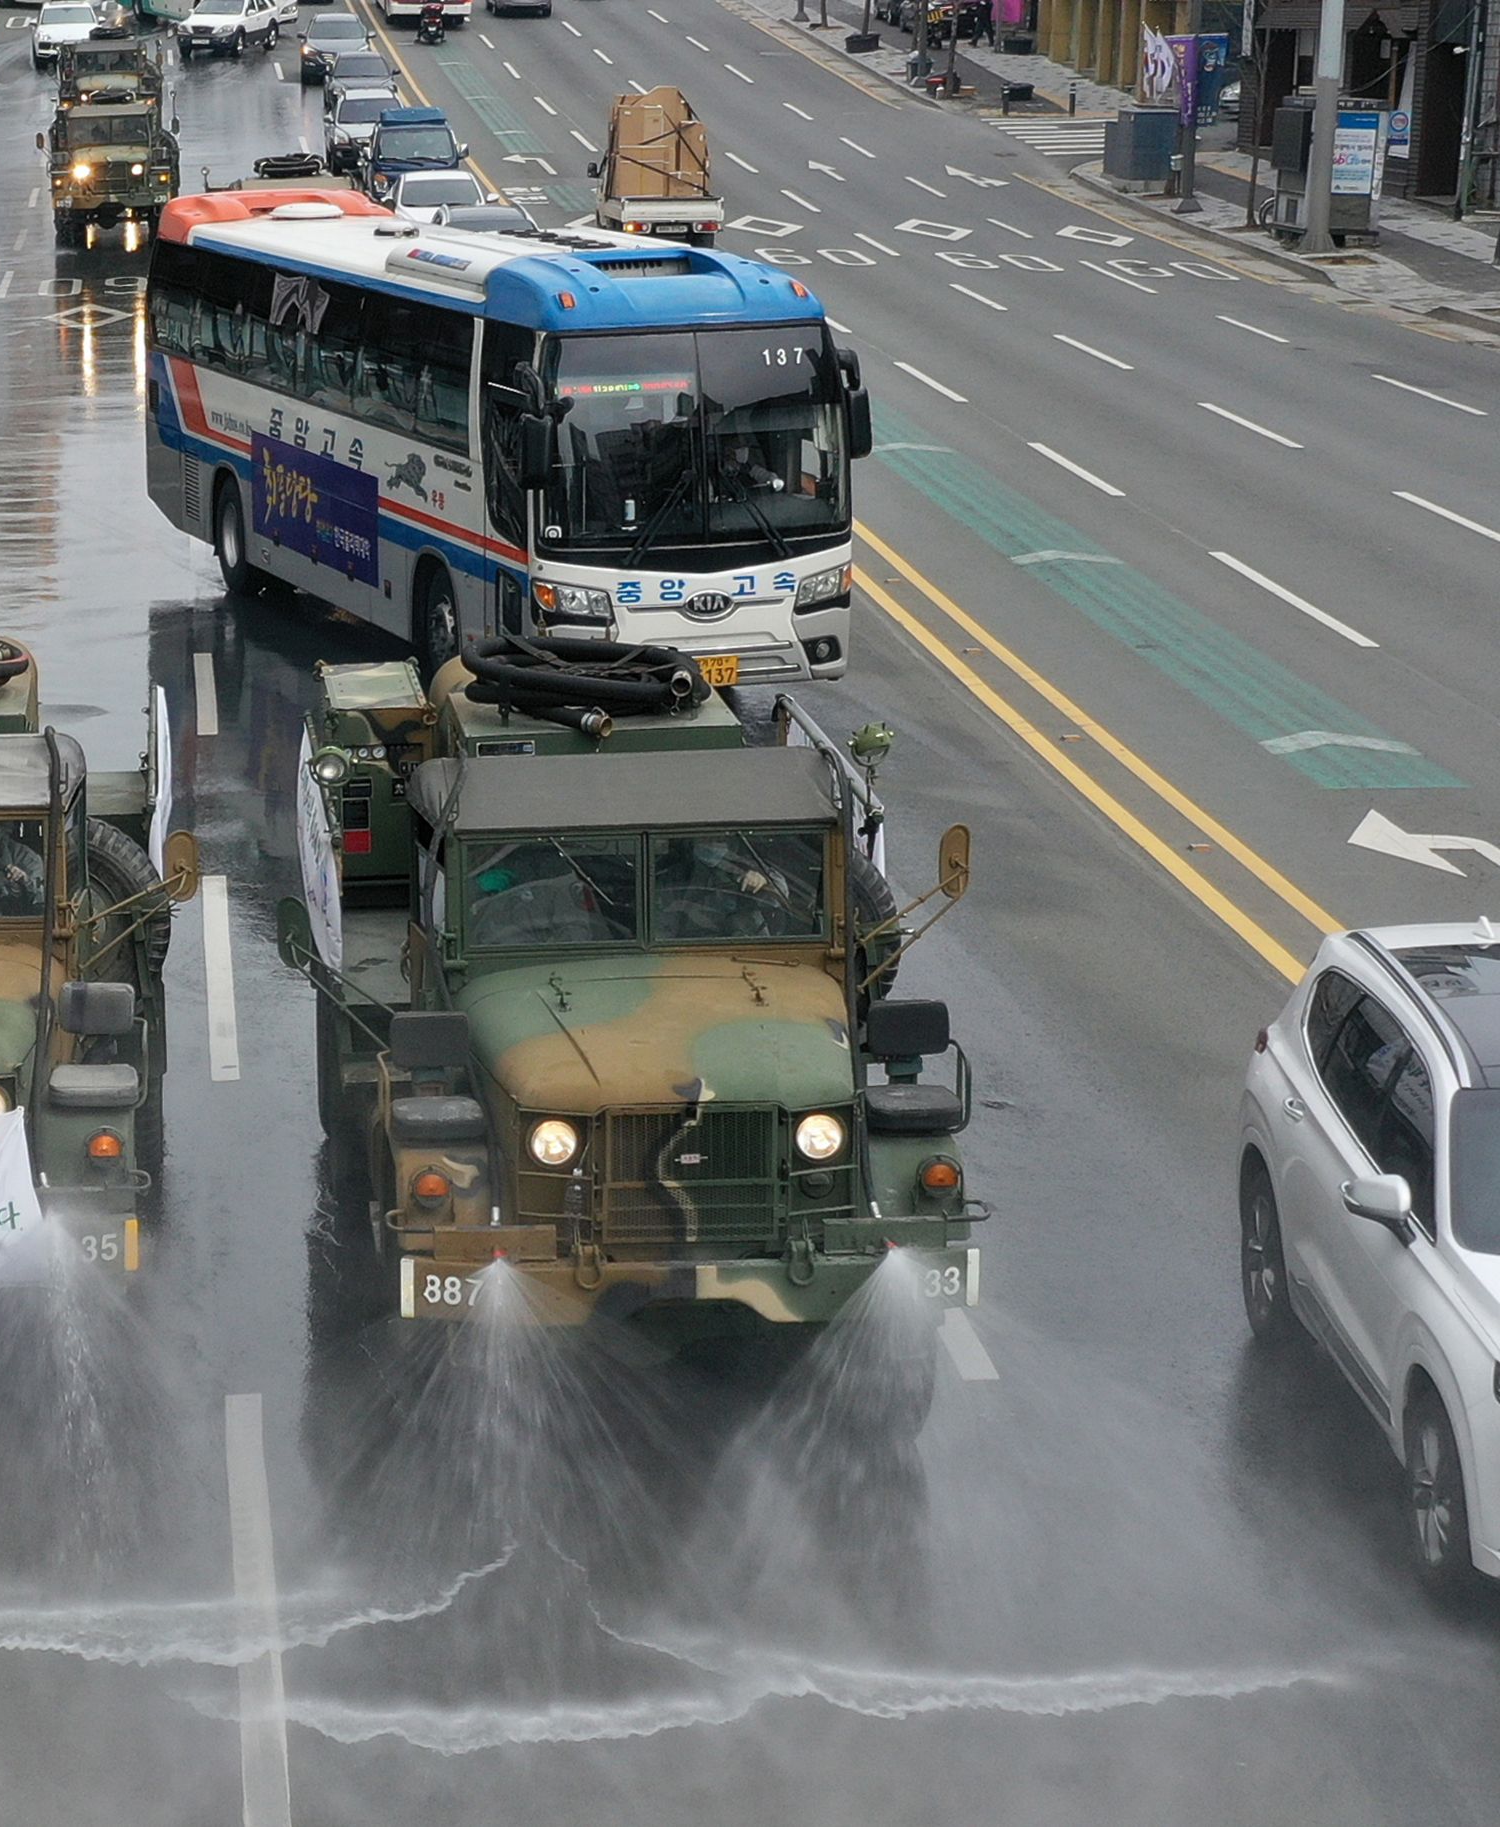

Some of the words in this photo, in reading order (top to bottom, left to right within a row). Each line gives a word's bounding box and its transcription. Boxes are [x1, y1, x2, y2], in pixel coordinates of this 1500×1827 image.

[754, 247, 878, 267] 60
[934, 251, 1065, 273] 60
[1105, 258, 1240, 281] 60
[761, 347, 804, 366] 137
[692, 596, 726, 611] KIA
[700, 667, 735, 685] 137
